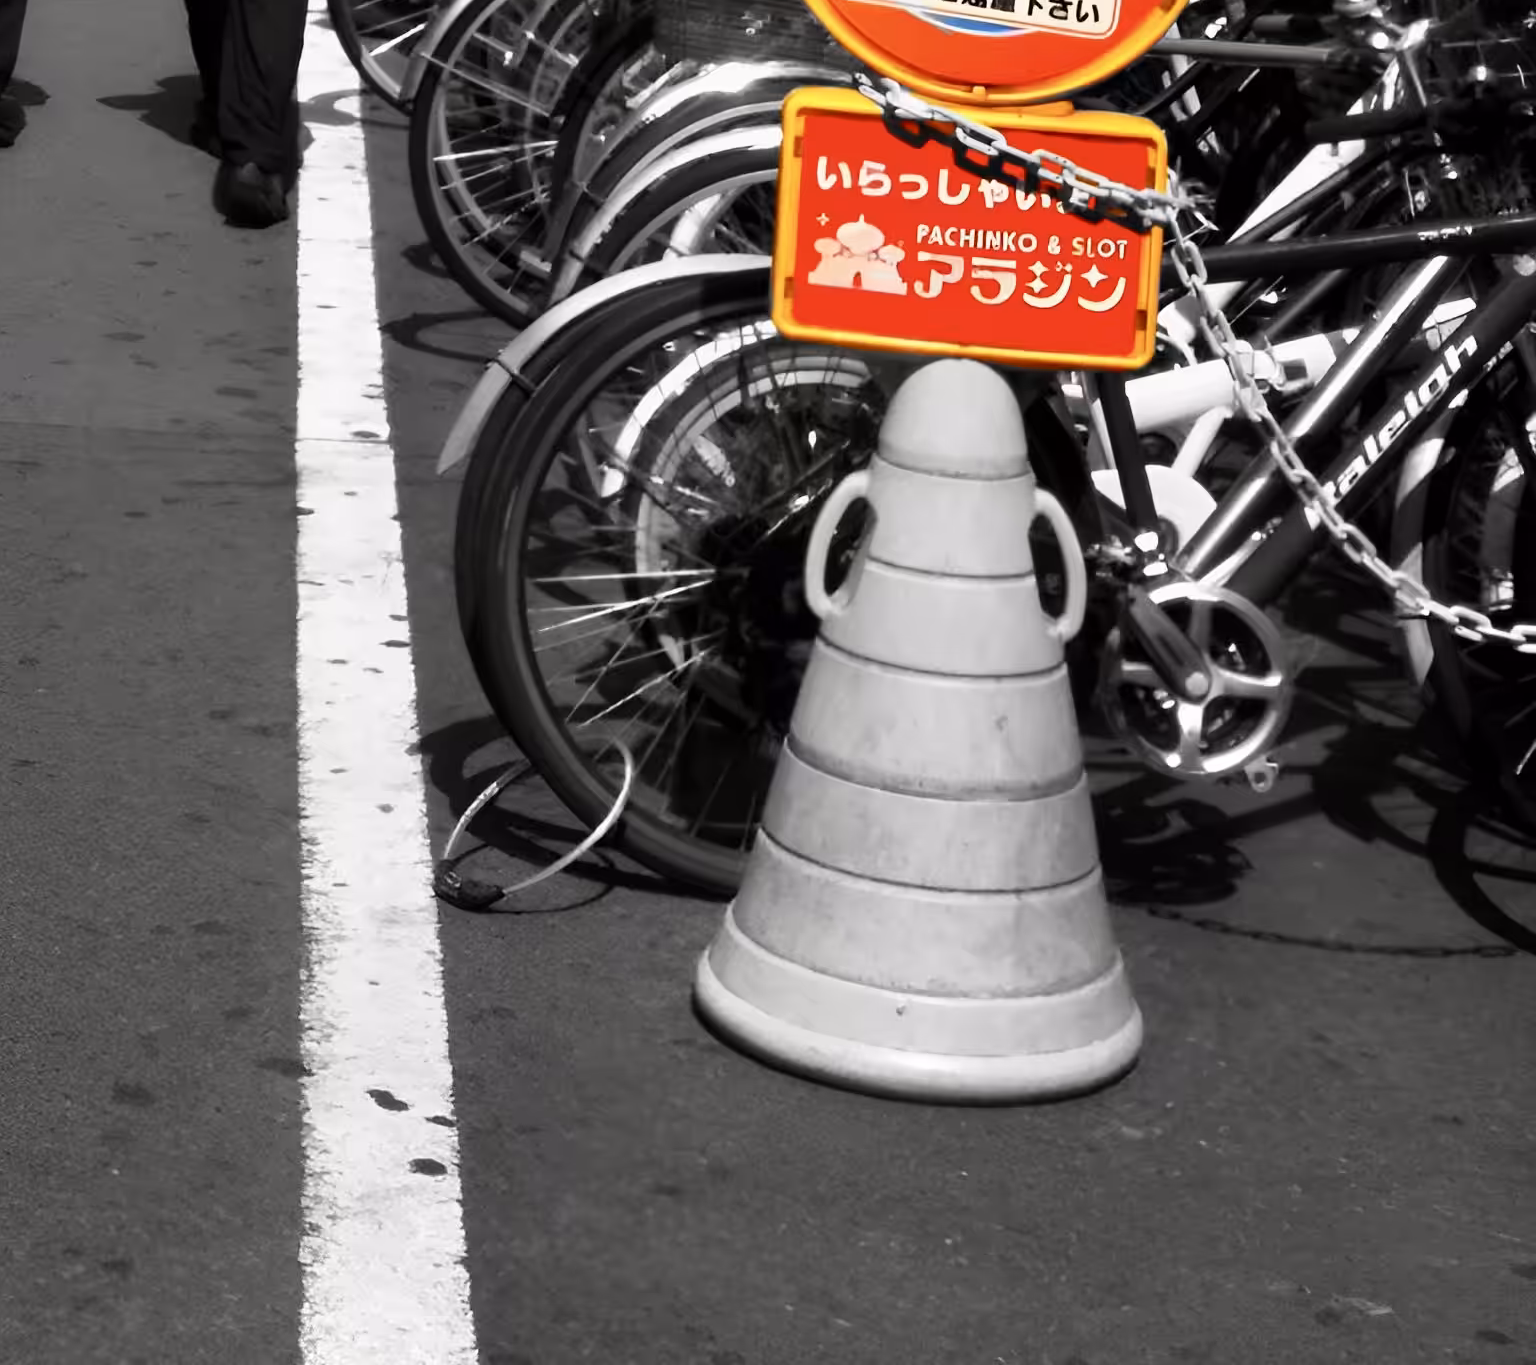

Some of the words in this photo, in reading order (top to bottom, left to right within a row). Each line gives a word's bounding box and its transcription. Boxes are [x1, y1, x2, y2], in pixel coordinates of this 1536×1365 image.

[916, 223, 1038, 254] PACHINKO
[1047, 235, 1061, 256] &
[1071, 236, 1128, 260] SLOT
[913, 251, 1127, 313] アラジン
